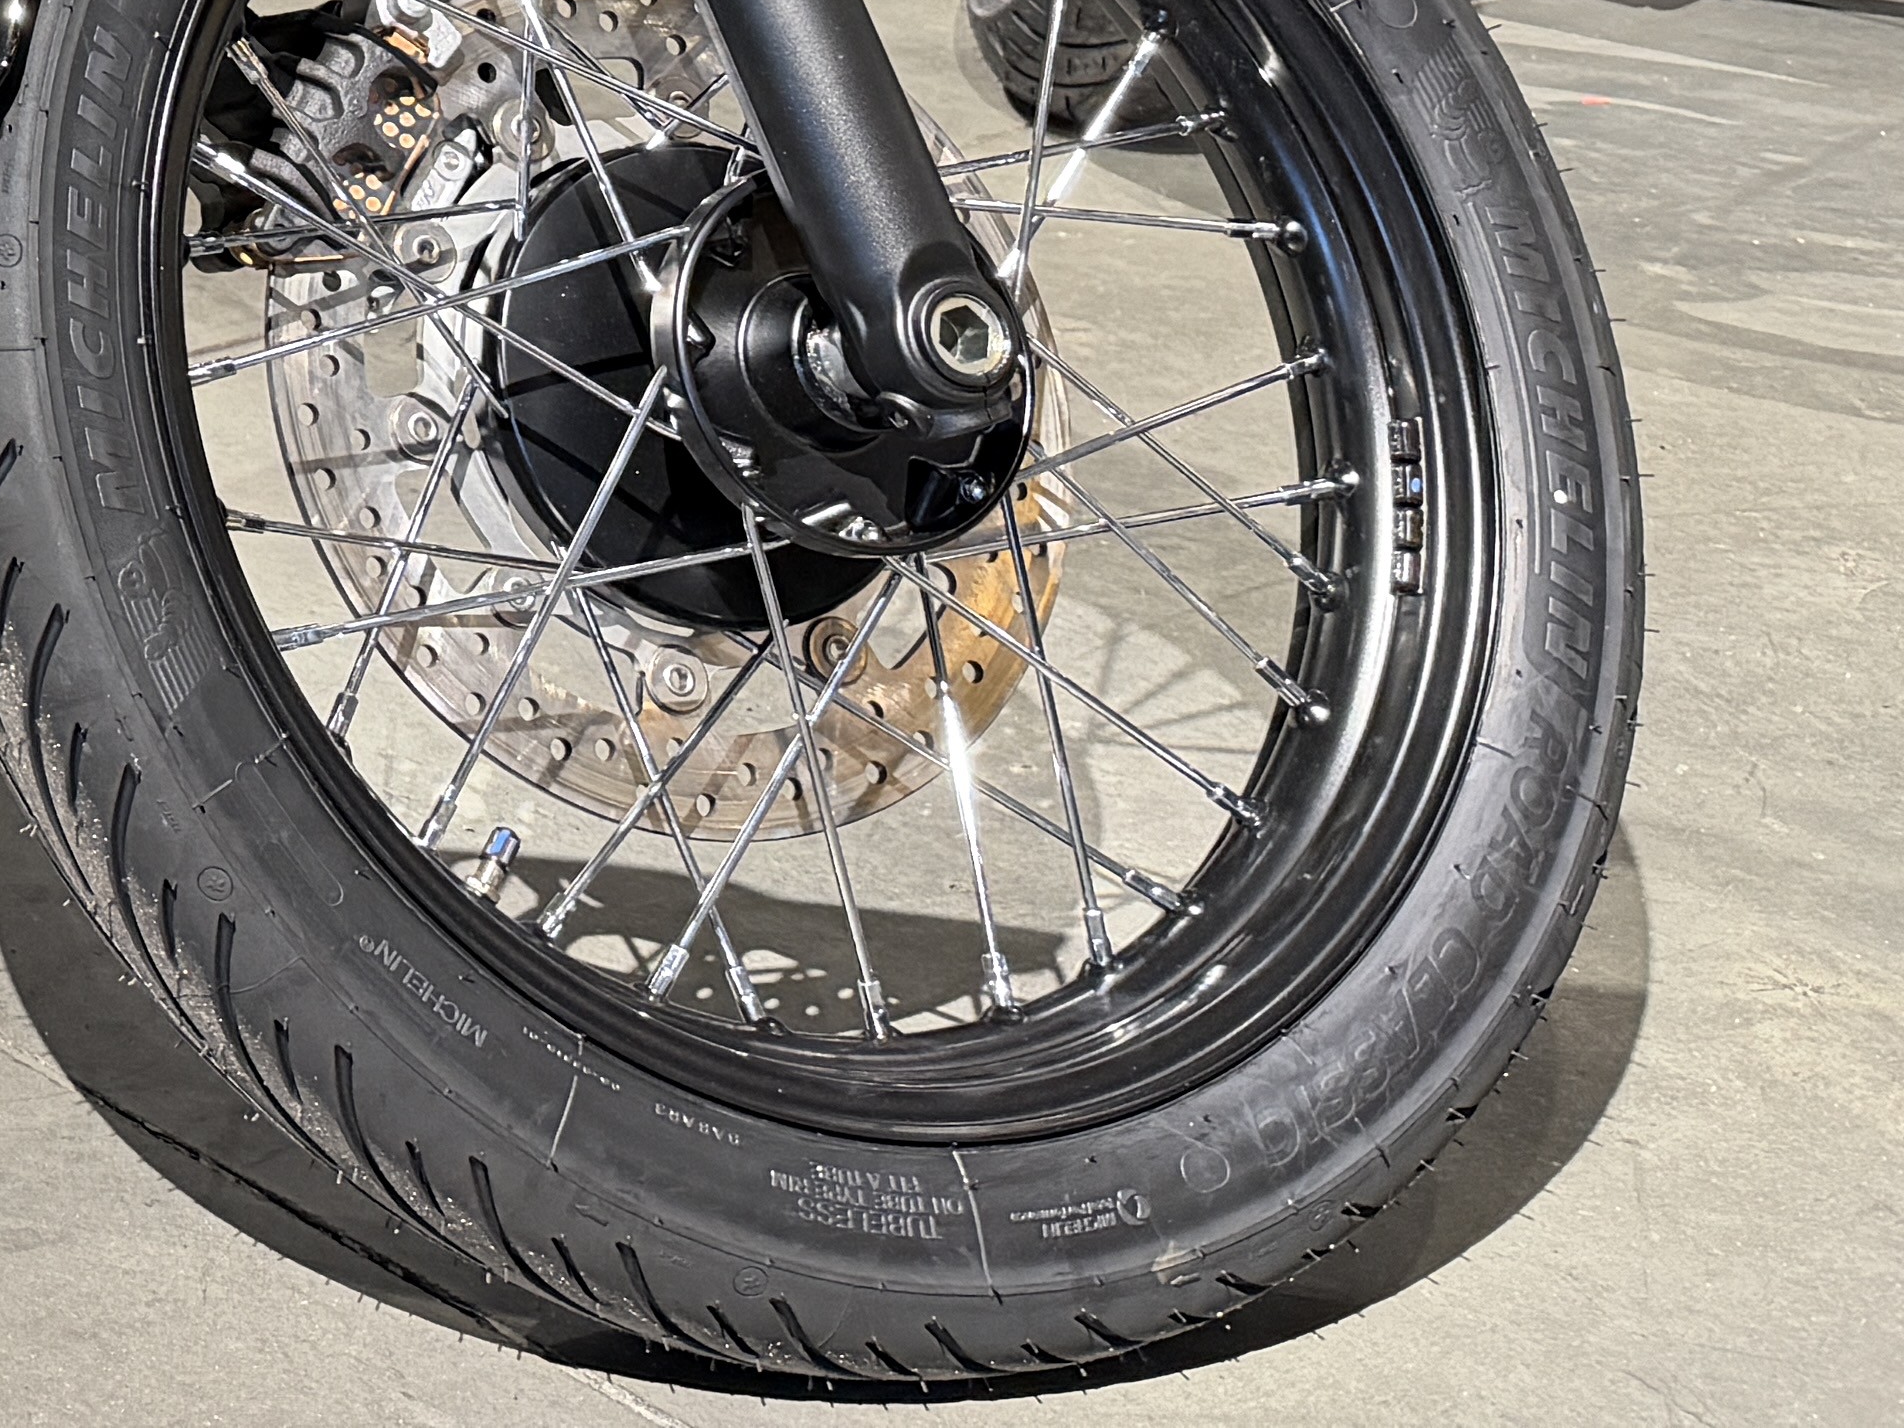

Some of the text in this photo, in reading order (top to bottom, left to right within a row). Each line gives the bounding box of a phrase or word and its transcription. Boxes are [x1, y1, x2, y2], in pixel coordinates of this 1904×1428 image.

[62, 23, 148, 517] MICHELIN
[1491, 205, 1596, 677] MICHELIN
[769, 1168, 814, 1198] RIM
[812, 1180, 867, 1208] TYPE
[796, 1195, 943, 1240] TUBELESS
[872, 1191, 928, 1214] TUBE
